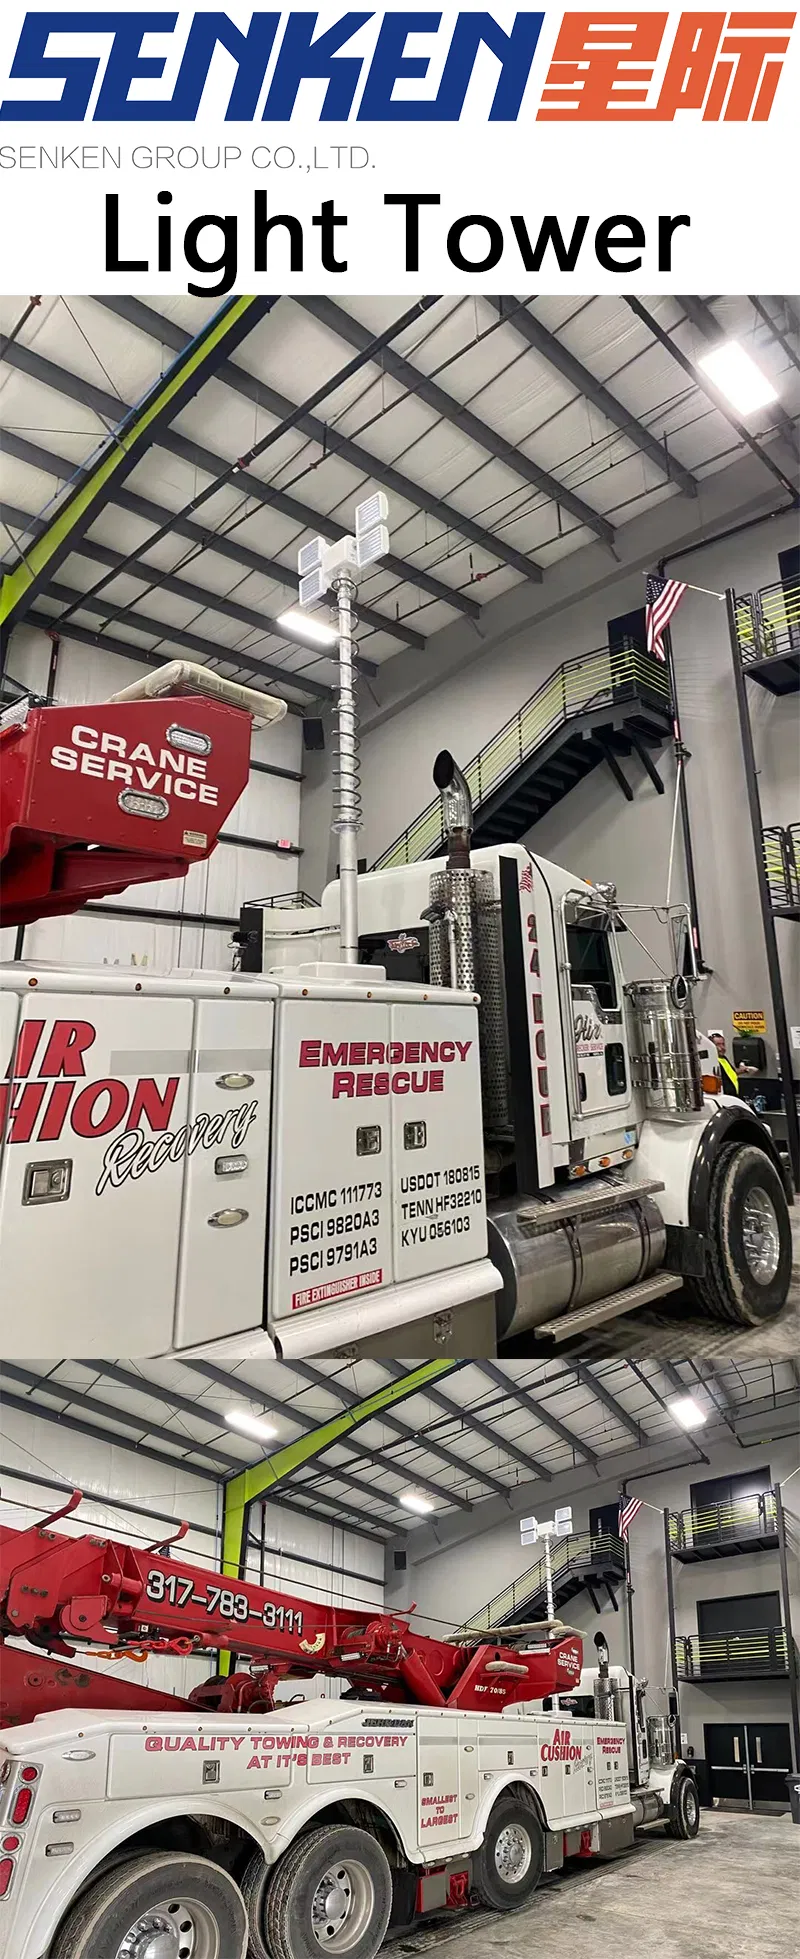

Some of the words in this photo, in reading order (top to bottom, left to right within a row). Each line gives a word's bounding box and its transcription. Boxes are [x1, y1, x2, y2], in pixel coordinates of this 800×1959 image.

[71, 725, 207, 780] CRANE
[51, 746, 218, 806] SERVICE
[733, 1012, 764, 1020] CAUTION
[96, 1100, 258, 1196] Recovery
[400, 1171, 440, 1194] USDOT
[443, 1165, 480, 1185] 180815
[290, 1188, 337, 1215] ICCMC
[340, 1181, 382, 1206] 111773
[401, 1198, 434, 1220] TENN
[435, 1188, 482, 1213] HF32210
[290, 1220, 324, 1245] PSCI
[326, 1209, 380, 1237] 9820A3
[401, 1225, 427, 1247] KYU
[429, 1215, 471, 1240] 056103
[289, 1250, 323, 1276] PSCI
[326, 1237, 378, 1267] 9791A3
[295, 1290, 311, 1307] FIRE
[311, 1276, 358, 1302] EXTINGUISHER
[359, 1270, 380, 1288] INSIDE
[146, 1570, 304, 1637] 317-783-3111
[557, 1658, 580, 1671] SERVICE
[559, 1651, 578, 1663] CRANE
[144, 1736, 245, 1752] QUALITY
[249, 1736, 319, 1750] TOWING
[323, 1736, 334, 1749] &
[337, 1736, 408, 1749] RECOVERY
[247, 1755, 273, 1770] AT
[276, 1753, 307, 1769] IT'S
[311, 1752, 351, 1767] BEST
[421, 1794, 458, 1806] SMALLEST
[436, 1806, 445, 1815] TO
[421, 1813, 459, 1829] LARGEST
